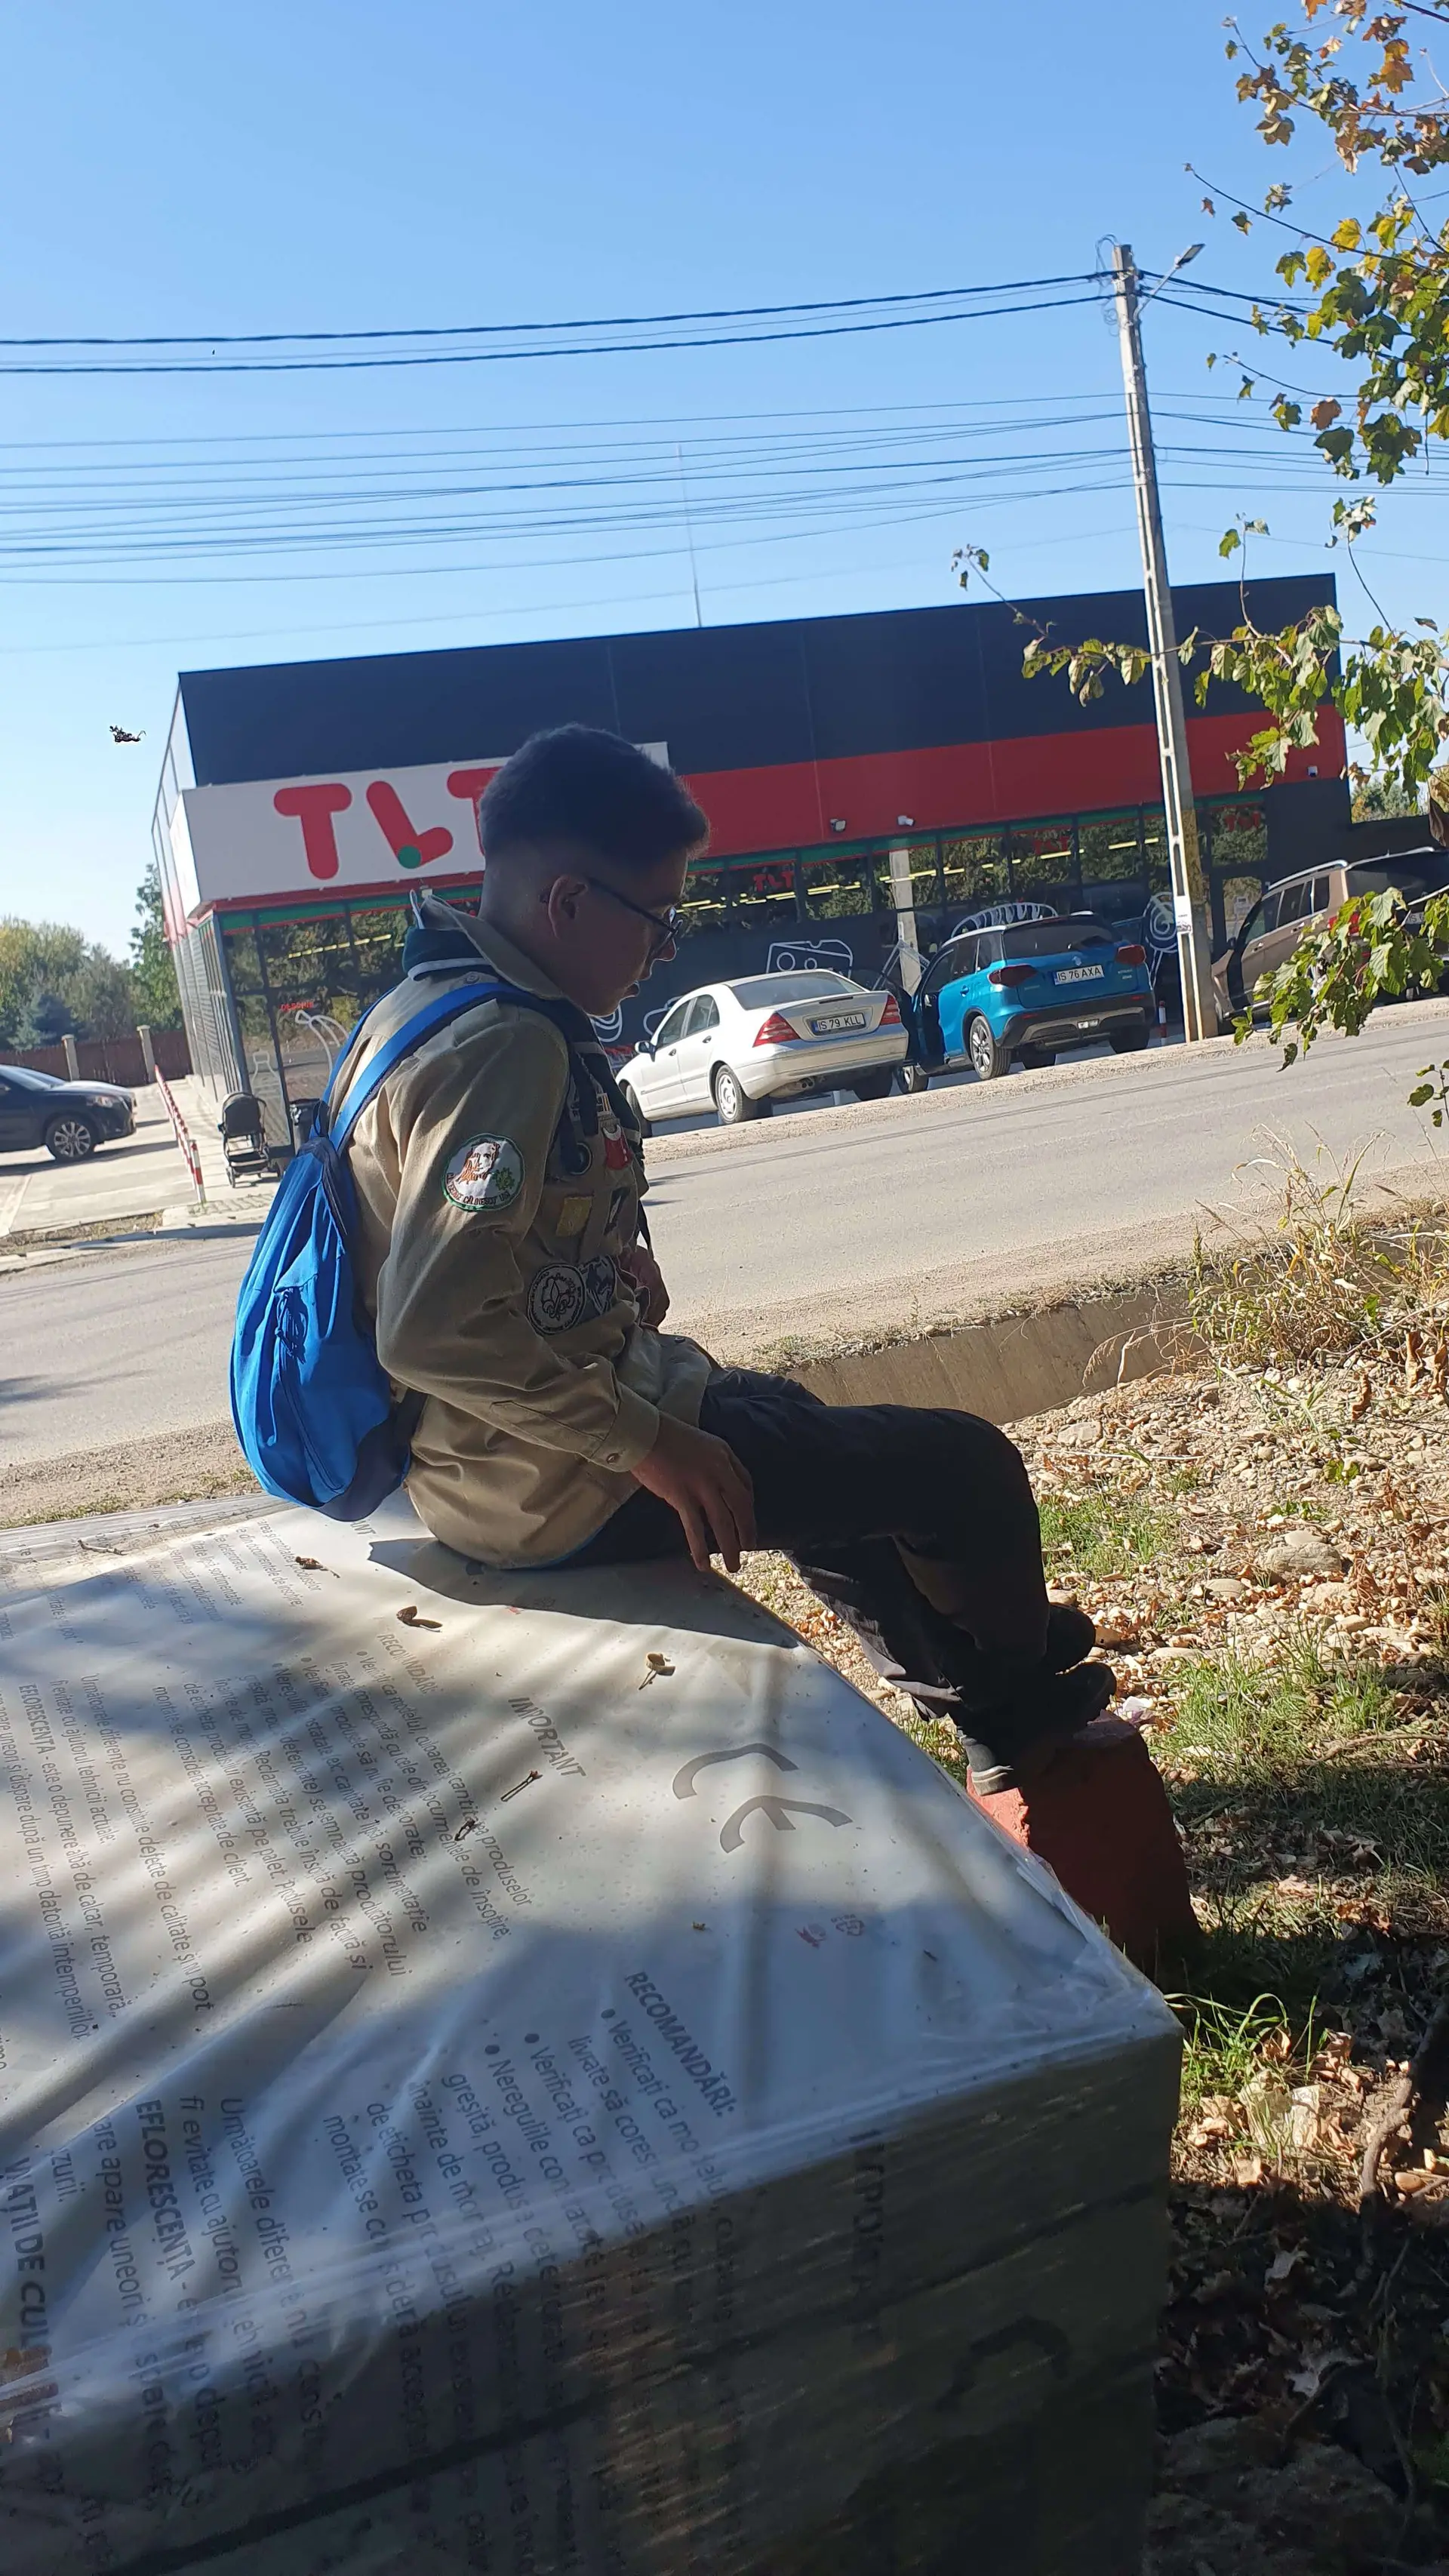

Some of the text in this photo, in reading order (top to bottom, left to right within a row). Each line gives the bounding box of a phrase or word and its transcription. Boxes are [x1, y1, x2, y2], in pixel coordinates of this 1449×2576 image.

[753, 870, 795, 892] TLT
[1058, 967, 1100, 981] IS 76 AXA
[819, 1016, 861, 1030] IS 79 KLL
[18, 1683, 57, 1755] EFLORESCENȚA
[508, 1697, 586, 1777] IMPORTANT
[63, 1728, 95, 1765] ajutorul
[356, 1750, 377, 1768] să
[7, 1773, 34, 1813] dispare
[42, 1762, 63, 1785] este
[77, 1759, 109, 1805] tehnicii
[114, 1771, 131, 1787] nu
[49, 1793, 80, 1850] depunere
[229, 1777, 268, 1825] existentă
[393, 1753, 417, 1777] cele
[460, 1865, 483, 1886] de
[16, 1814, 47, 1845] după
[89, 1805, 117, 1845] actuale:
[216, 1830, 239, 1849] de
[245, 1827, 269, 1848] pe
[27, 1848, 45, 1864] un
[28, 1864, 53, 1888] timp
[65, 1846, 92, 1870] albă
[137, 1836, 168, 1878] defecte
[223, 1852, 253, 1888] client.
[254, 1750, 291, 1806] Reclamația
[278, 1807, 311, 1848] trebuie
[321, 1887, 343, 1911] de
[346, 1953, 374, 1970] și
[478, 1835, 533, 1907] produselor
[72, 1871, 97, 1891] de
[153, 1879, 177, 1901] de
[309, 1797, 327, 1813] se
[345, 1869, 413, 1977] producătorului
[375, 1842, 431, 1934] sortimentație
[38, 1889, 74, 1940] datorită
[78, 1894, 105, 1931] calcar,
[160, 1904, 192, 1952] calitate
[51, 1941, 95, 2040] intemperiilor
[89, 1934, 133, 2017] temporară,
[182, 1975, 214, 2011] pot
[624, 1970, 737, 2118] RECOMANDĂRI:
[567, 2034, 630, 2113] livrate să
[607, 2019, 672, 2097] Verificați
[652, 2096, 678, 2120] ca
[178, 2094, 206, 2112] fi
[366, 2102, 395, 2128] de
[440, 2072, 499, 2141] greșită,
[486, 2057, 554, 2153] Neregulile
[530, 2045, 597, 2147] Verificați ca
[181, 2117, 216, 2195] evitate
[219, 2097, 278, 2211] Următoarele
[322, 2114, 380, 2214] montate se
[377, 2125, 424, 2204] eticheta
[435, 2151, 466, 2180] de
[94, 2156, 128, 2234] apare
[136, 2099, 197, 2281] EFLORESCENȚA
[198, 2192, 224, 2216] cu
[14, 2232, 46, 2273] DE
[109, 2235, 152, 2310] uneori
